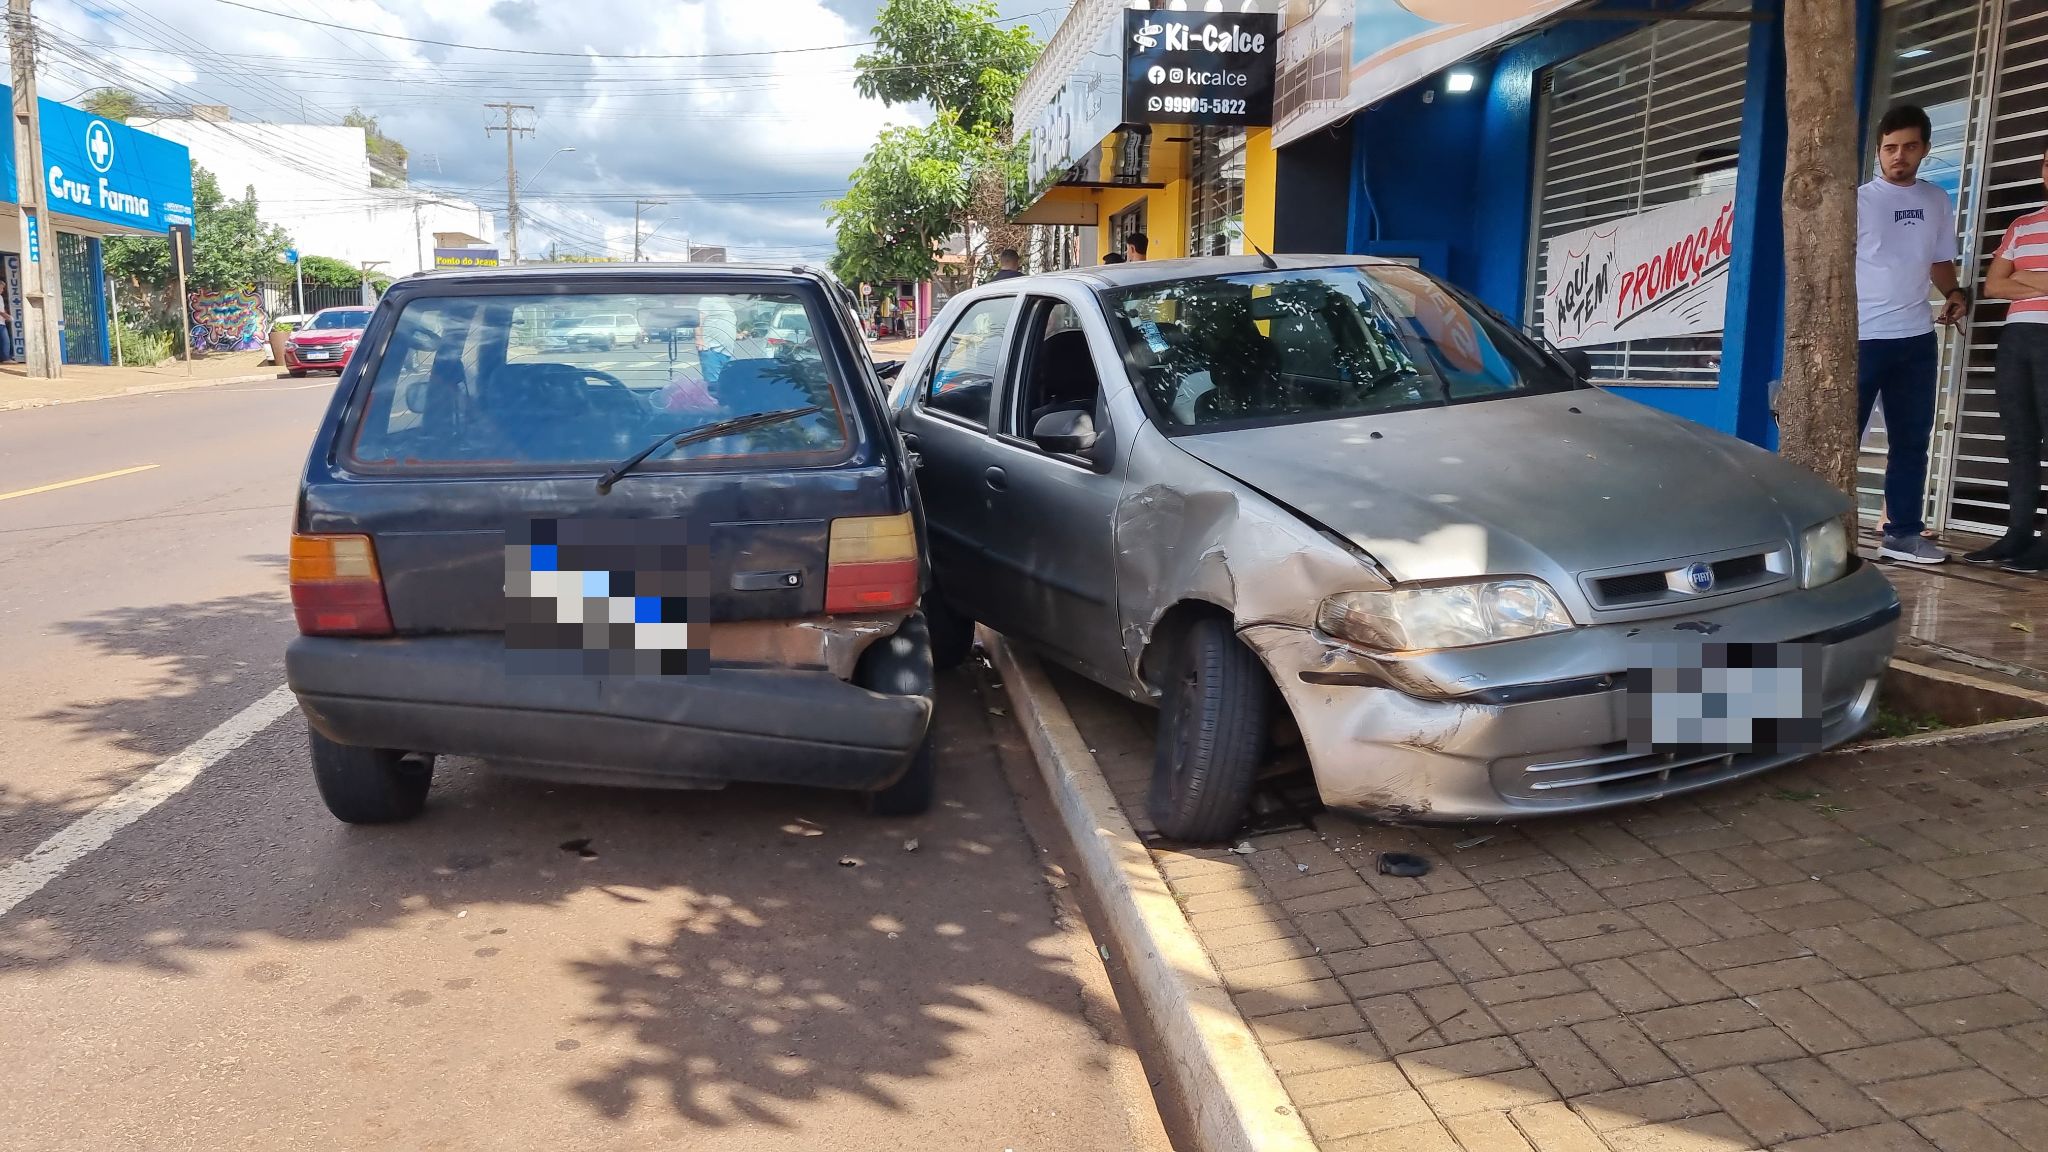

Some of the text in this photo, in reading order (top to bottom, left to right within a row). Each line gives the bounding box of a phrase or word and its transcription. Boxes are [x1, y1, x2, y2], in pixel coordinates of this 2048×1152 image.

[1165, 22, 1265, 54] Ki-Calce
[1187, 68, 1248, 87] kicalce
[1164, 96, 1246, 115] 99905-5822
[49, 165, 92, 206] Cruz
[99, 177, 150, 218] Farma
[462, 256, 473, 266] do
[474, 257, 498, 267] Jeans
[1693, 571, 1710, 583] FIAT
